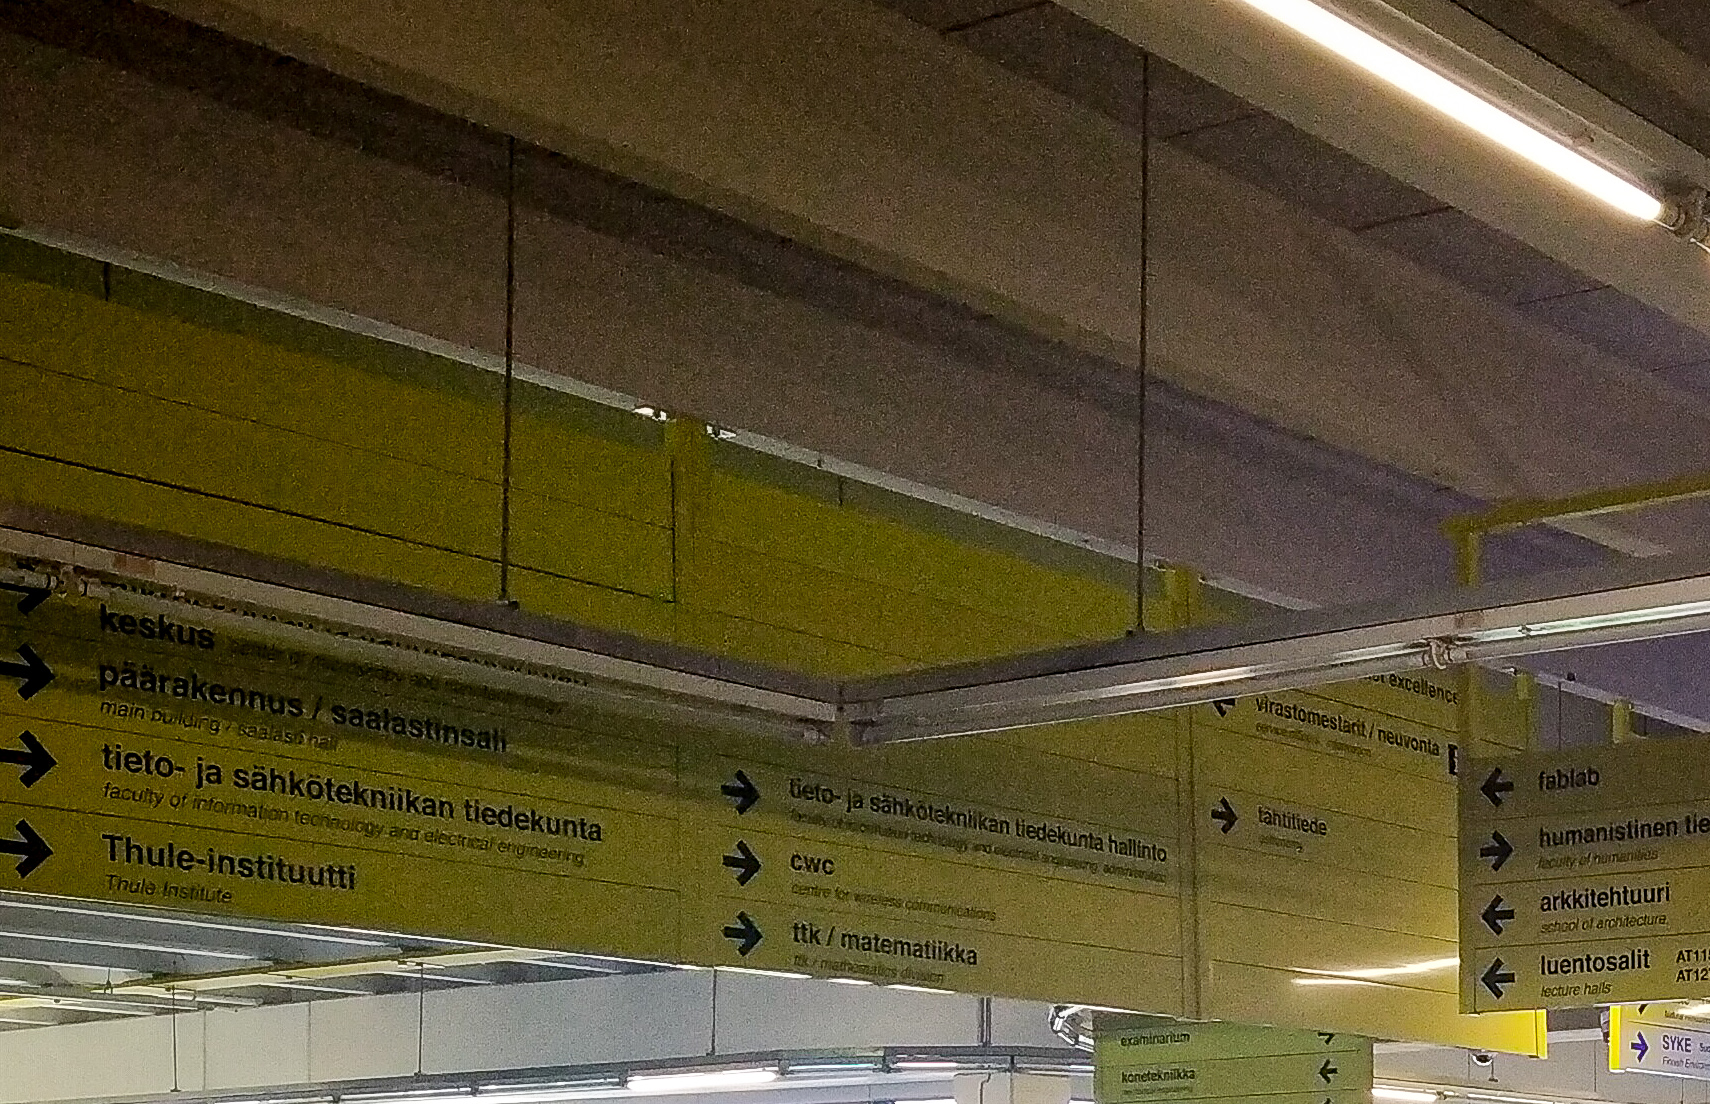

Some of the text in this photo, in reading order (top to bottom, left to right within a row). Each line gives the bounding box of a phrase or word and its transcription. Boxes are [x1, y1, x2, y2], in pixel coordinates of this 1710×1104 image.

[99, 602, 216, 650] keskus
[99, 661, 304, 717] päärakennus
[331, 704, 508, 754] saalastinsali
[100, 700, 145, 721] main
[1255, 695, 1366, 739] virastomestarit
[1377, 728, 1441, 757] neuvonta
[102, 743, 604, 842] tieto- ja sähkötekniikan tiedekunta
[1538, 766, 1601, 793] fablab
[169, 793, 188, 810] of
[788, 777, 842, 806] tieto-
[845, 787, 864, 814] ja
[869, 793, 1011, 835] sähkötekniikan
[1015, 818, 1104, 852] tiedekunta
[1107, 833, 1168, 864] hallinto
[1539, 818, 1678, 849] humanistinen
[101, 833, 356, 891] Thule-instituutti
[789, 853, 836, 876] cwc
[105, 873, 157, 896] Thule
[1540, 882, 1671, 913] arkkitehtuuri
[1540, 917, 1580, 935] school
[792, 920, 822, 946] ttk
[840, 931, 979, 966] matematiikka
[1540, 949, 1651, 976] luentosalit
[1541, 981, 1613, 999] lecture halls
[1662, 1034, 1692, 1054] SYKE
